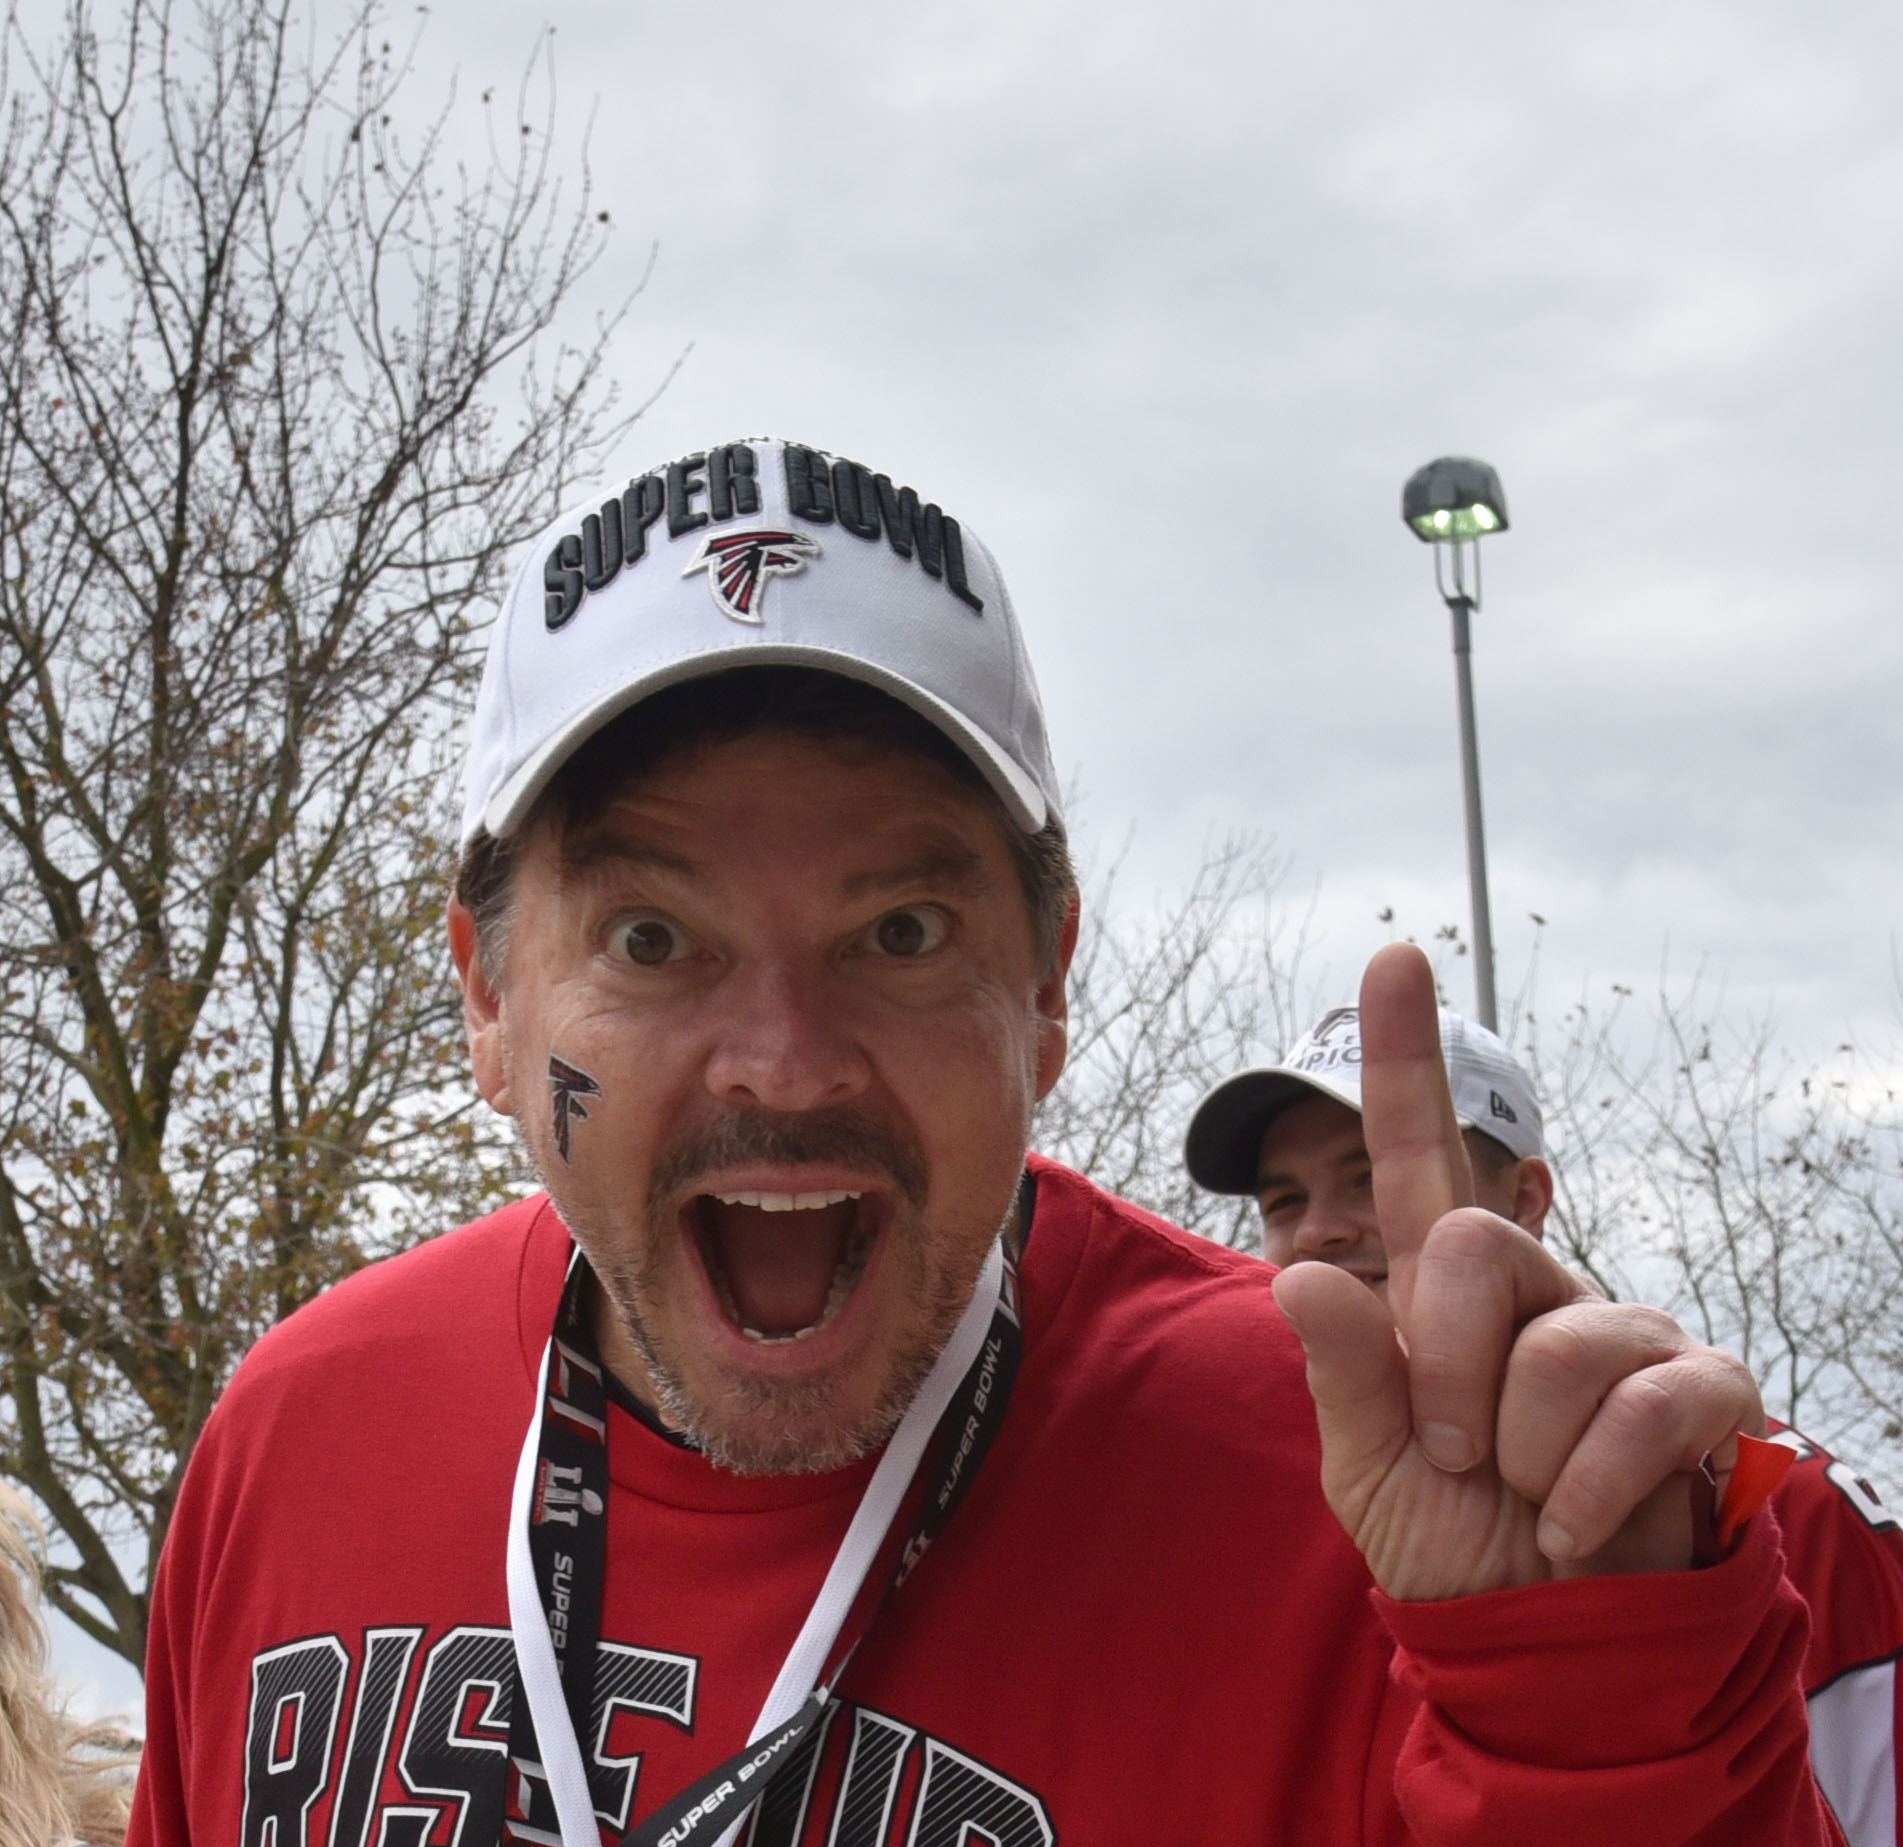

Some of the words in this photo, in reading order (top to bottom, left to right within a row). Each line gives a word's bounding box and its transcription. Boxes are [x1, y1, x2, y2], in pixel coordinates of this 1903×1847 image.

[543, 443, 760, 633] SUPER
[783, 444, 984, 618] BOWL
[937, 1413, 981, 1511] SUPER
[973, 1336, 1002, 1411] BOWL
[737, 1724, 804, 1783] BOWL
